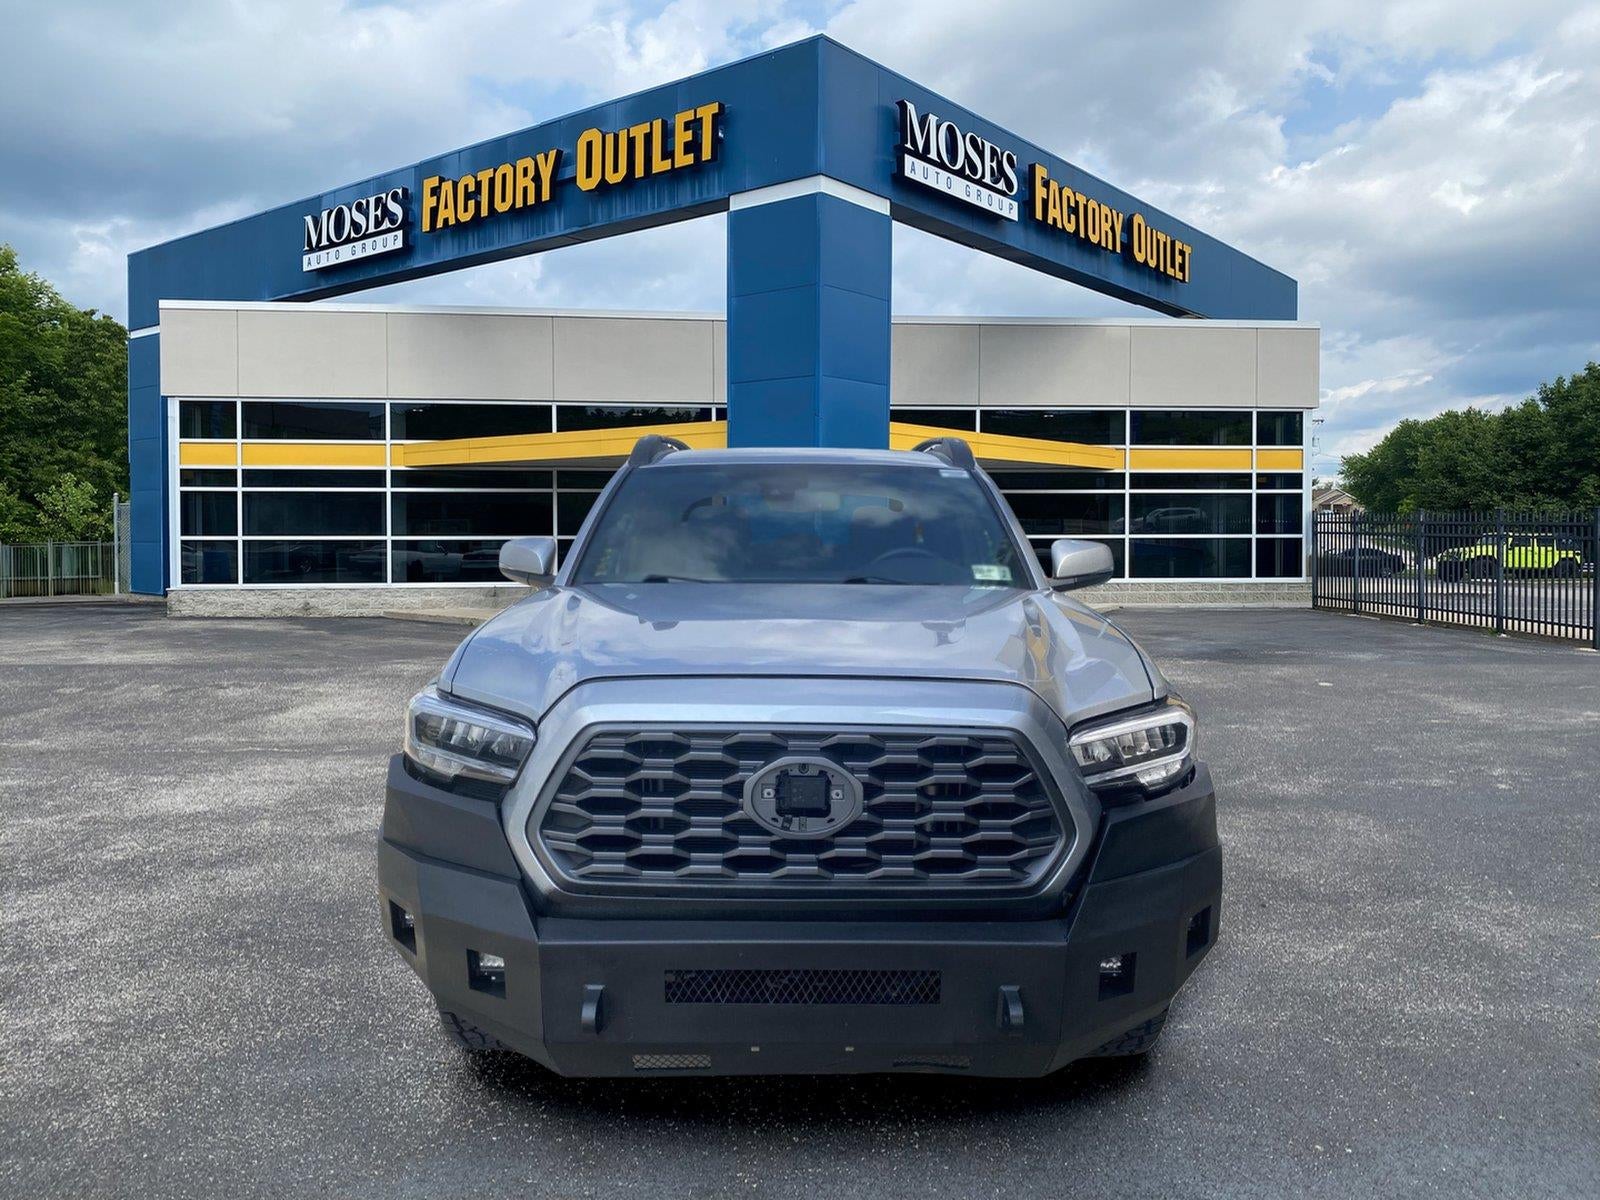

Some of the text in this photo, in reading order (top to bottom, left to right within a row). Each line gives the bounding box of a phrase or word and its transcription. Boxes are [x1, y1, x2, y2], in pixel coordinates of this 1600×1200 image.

[421, 102, 720, 232] FACTORY OUTLET
[903, 99, 1018, 195] MOSES
[303, 188, 404, 250] MOSES
[909, 161, 1015, 215] AUTO GROUP
[1034, 163, 1192, 283] FACTORY OUTLET
[306, 236, 402, 267] AUTO GROUP
